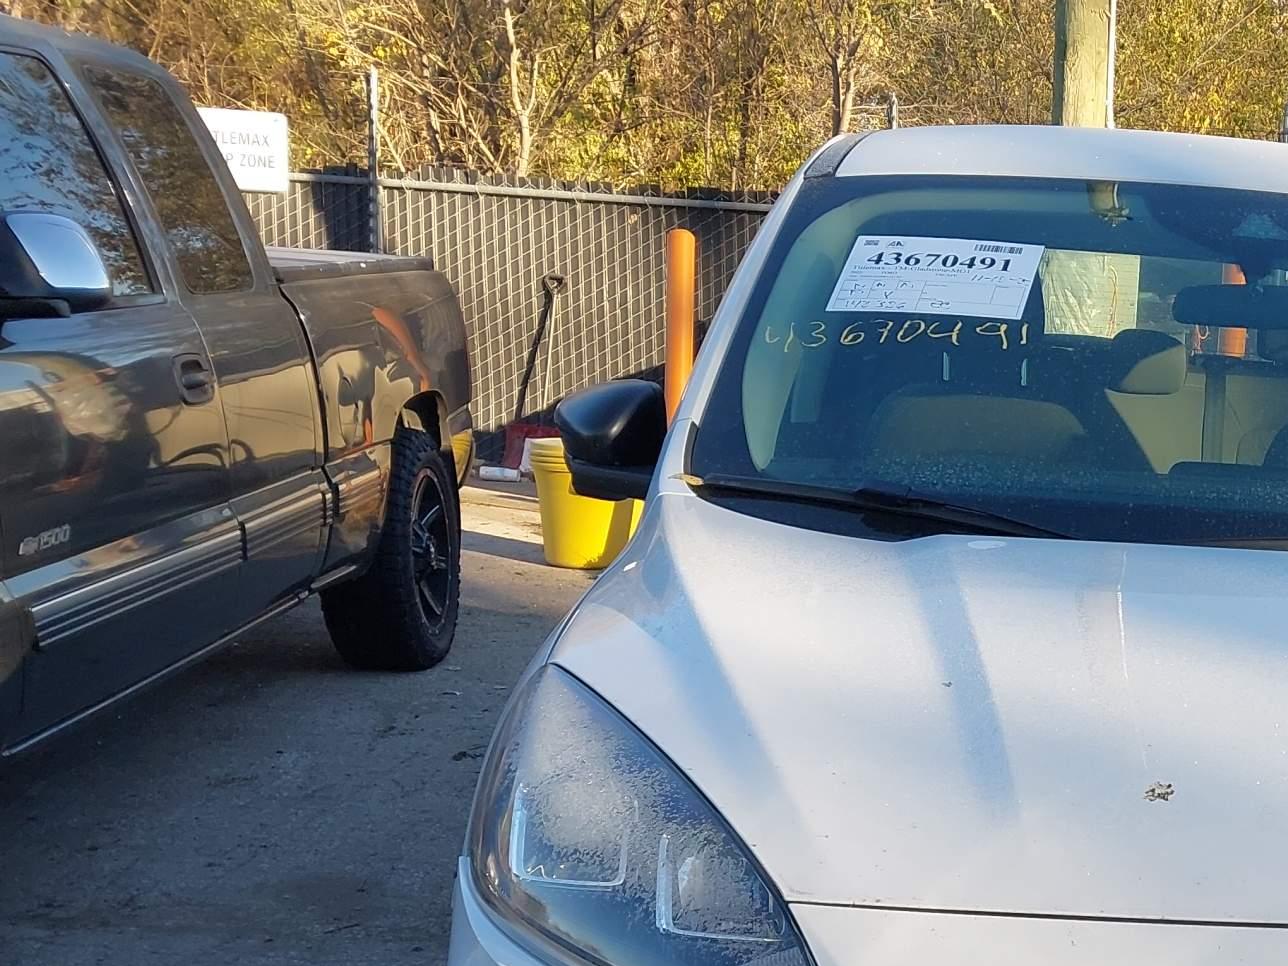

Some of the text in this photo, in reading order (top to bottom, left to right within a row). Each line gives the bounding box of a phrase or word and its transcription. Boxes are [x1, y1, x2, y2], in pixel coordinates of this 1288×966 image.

[212, 130, 270, 147] TLEMAX
[240, 153, 277, 169] ZONE
[866, 251, 1012, 273] 43670491
[765, 319, 1029, 352] 43670491
